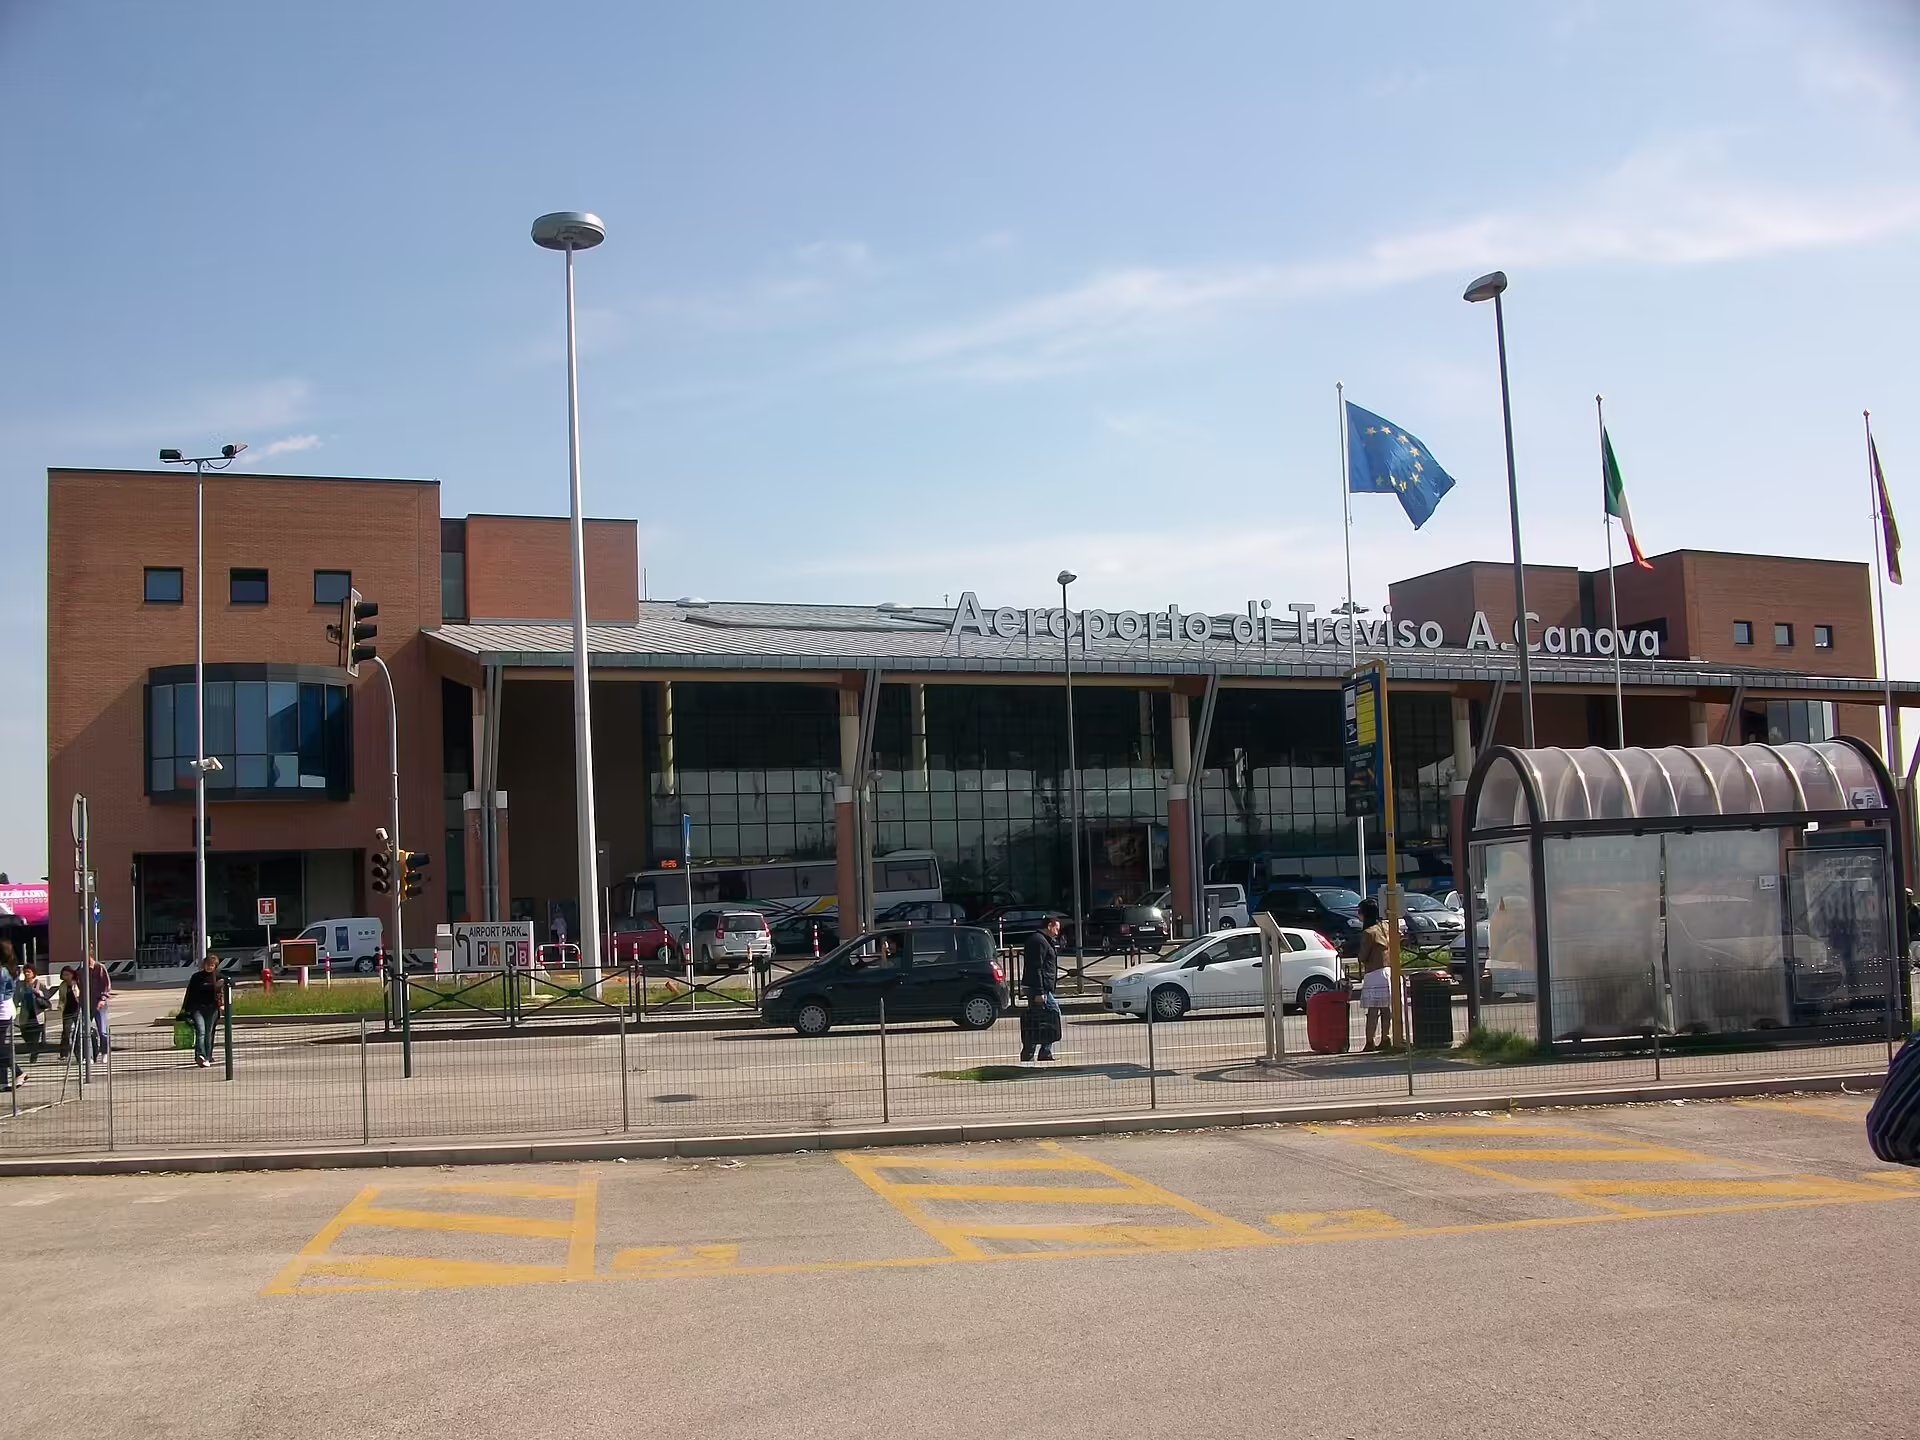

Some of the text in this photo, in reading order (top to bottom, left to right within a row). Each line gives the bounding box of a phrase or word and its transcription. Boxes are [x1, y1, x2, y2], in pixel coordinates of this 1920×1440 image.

[951, 591, 1212, 650] Aeroporto
[1231, 599, 1273, 644] di
[1288, 603, 1444, 649] Treviso
[469, 926, 500, 937] AIRPORT
[502, 926, 521, 937] PARK
[479, 944, 527, 965] P A P B
